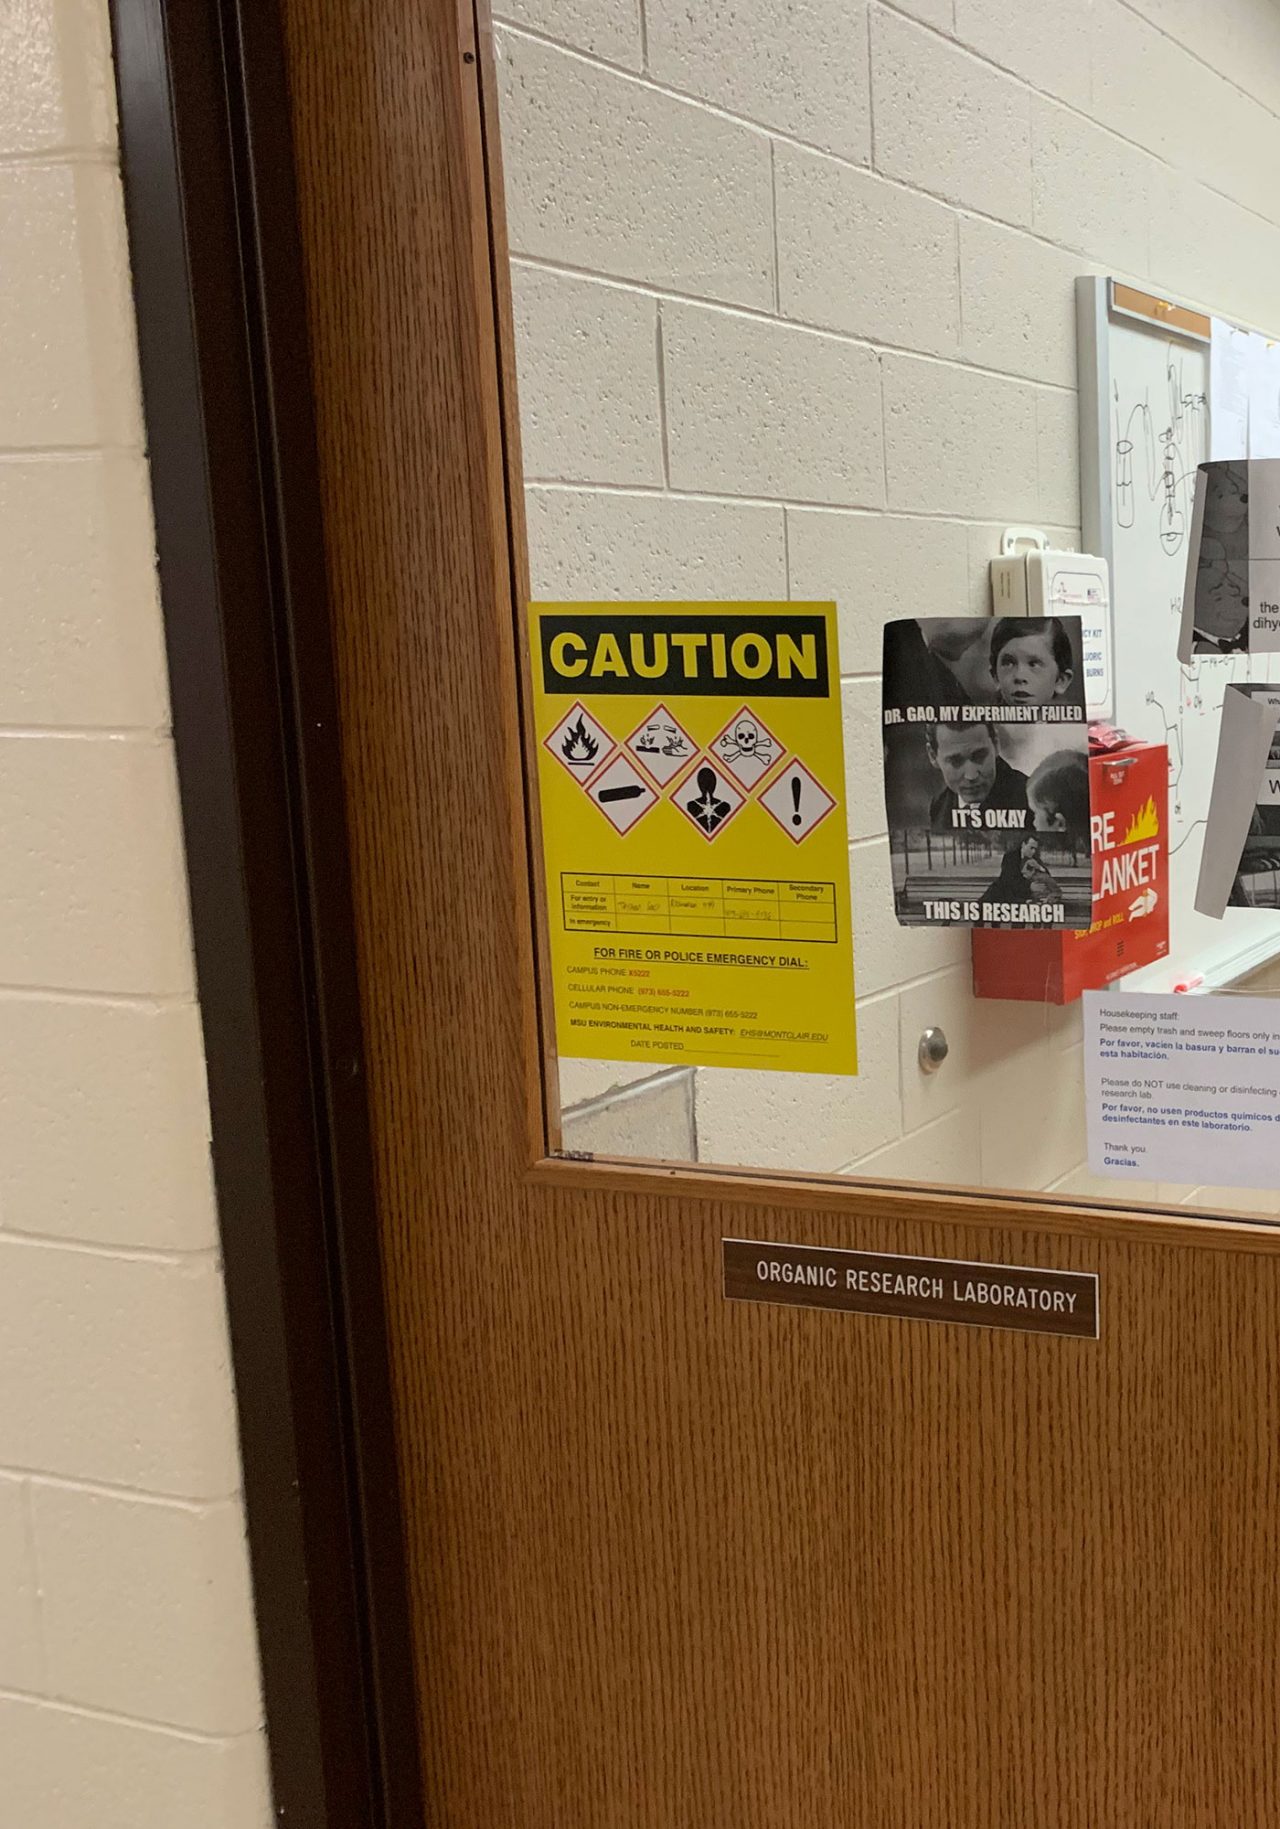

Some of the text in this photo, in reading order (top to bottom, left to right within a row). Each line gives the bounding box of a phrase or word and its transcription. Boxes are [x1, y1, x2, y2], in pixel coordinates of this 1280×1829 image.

[1260, 602, 1279, 613] the
[550, 632, 817, 680] CAUTION
[884, 705, 1082, 725] DR. GAO, MY EXPERIMENT FAILED
[952, 809, 1026, 828] IT'S OKAY
[1091, 811, 1116, 853] RE
[1092, 844, 1159, 901] ANKET
[727, 886, 775, 895] Primary Phone
[789, 884, 824, 893] Secondary
[582, 895, 598, 903] entry
[923, 901, 1065, 922] THIS IS RESEARCH
[577, 919, 611, 927] emergency
[594, 947, 808, 967] FOR FIRE OR POLICE EMERGENCY DIAL:
[567, 965, 598, 975] CAMPUS
[568, 983, 606, 993] CELLULAR
[569, 1001, 601, 1010] CAMPUS
[602, 1003, 668, 1014] NON-EMERGENCY
[670, 1007, 703, 1016] NUMBER
[705, 1008, 723, 1018] (973)
[1099, 1009, 1157, 1020] Housekeeping
[570, 1019, 587, 1027] MSU
[589, 1020, 651, 1031] ENVIRONMENTAL
[654, 1023, 684, 1032] HEALTH
[685, 1025, 702, 1033] AND
[1099, 1023, 1128, 1032] Please
[1129, 1026, 1154, 1035] empty
[1157, 1027, 1177, 1035] trash
[1179, 1028, 1195, 1036] and
[1197, 1030, 1225, 1039] sweep
[1227, 1029, 1250, 1039] floors
[1252, 1032, 1270, 1042] only
[631, 1040, 684, 1050] DATE POSTED
[1099, 1038, 1114, 1046] Por
[1117, 1039, 1143, 1048] favor,
[1175, 1042, 1183, 1050] la
[1185, 1042, 1216, 1052] basura
[1218, 1045, 1224, 1054] y
[1227, 1044, 1255, 1054] barran
[1258, 1046, 1266, 1054] el
[1099, 1050, 1118, 1058] esta
[1101, 1078, 1129, 1086] Please
[1131, 1079, 1142, 1087] do
[1144, 1080, 1164, 1089] NOT
[1166, 1082, 1181, 1090] use
[1182, 1083, 1216, 1094] cleaning
[1230, 1085, 1277, 1098] disinfecting
[1101, 1090, 1137, 1098] research
[1102, 1102, 1118, 1111] Por
[1119, 1104, 1145, 1113] favor,
[1160, 1107, 1182, 1115] usen
[1184, 1109, 1228, 1120] productos
[1102, 1114, 1165, 1125] desinfectantes
[1104, 1142, 1128, 1151] Thank
[1103, 1157, 1140, 1167] Gracias.
[757, 1260, 1077, 1313] ORGANIC RESEARCH LABORATORY
